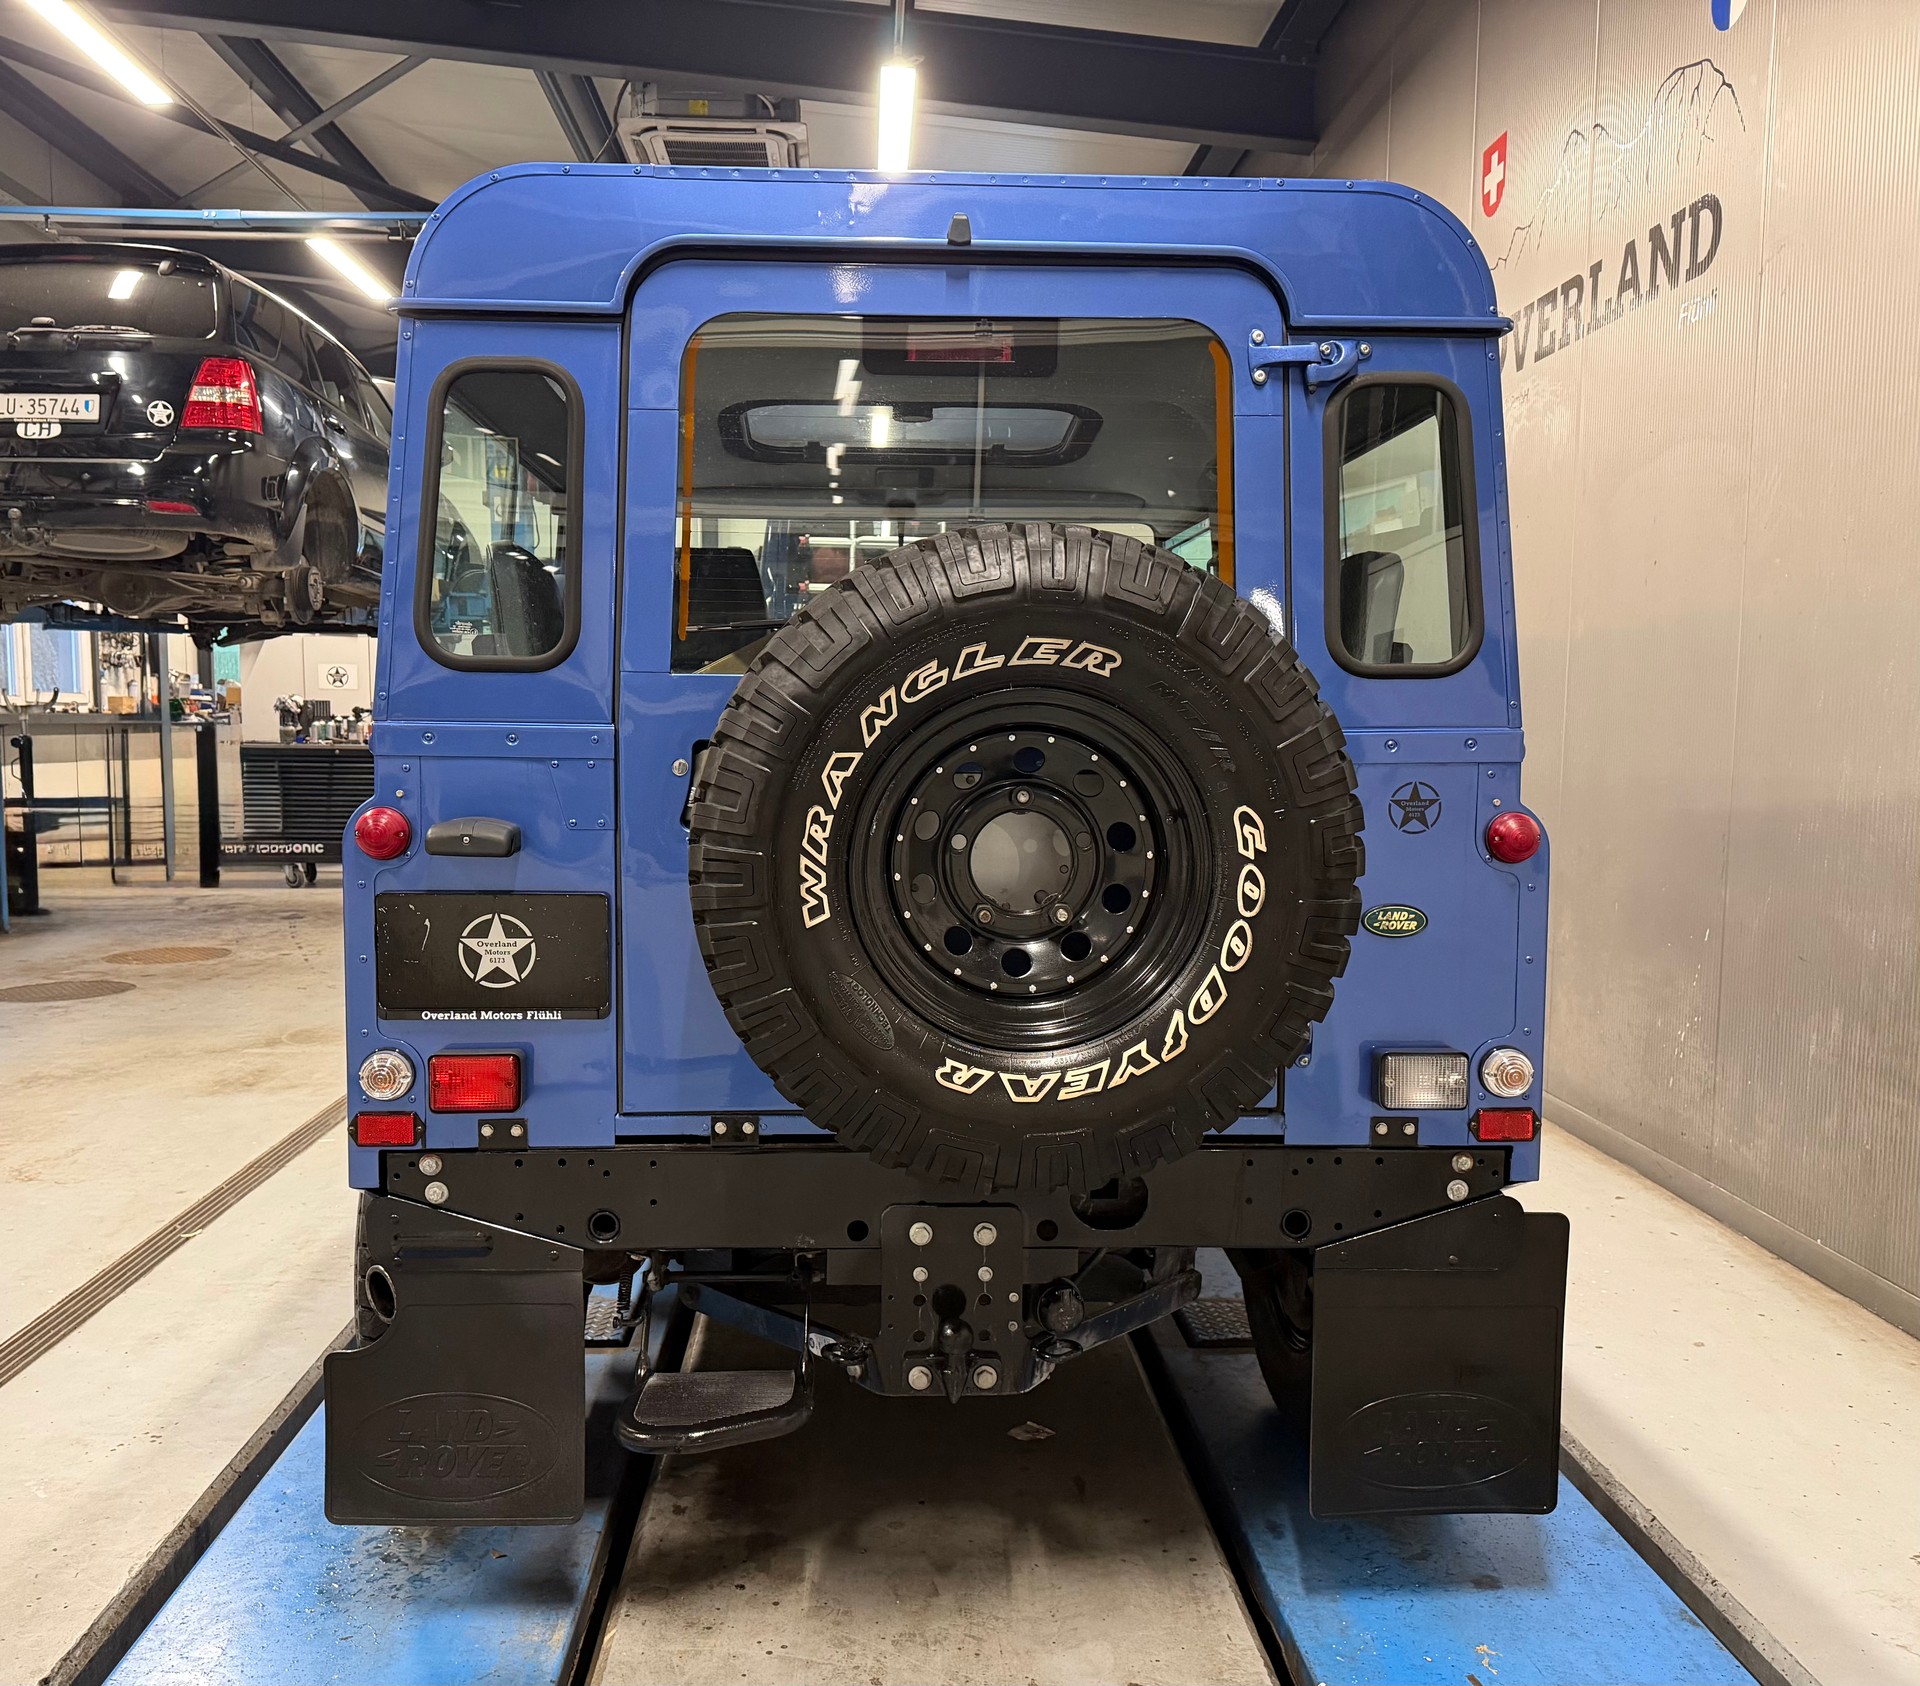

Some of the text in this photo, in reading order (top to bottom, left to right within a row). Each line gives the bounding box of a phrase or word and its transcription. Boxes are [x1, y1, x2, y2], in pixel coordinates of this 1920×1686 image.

[799, 636, 1123, 930] WRANGLER
[1378, 911, 1409, 921] LAND
[1379, 920, 1418, 931] ROVER
[476, 940, 518, 948] Overland
[934, 805, 1267, 1103] GOODYEAR
[421, 1010, 562, 1020] Overland Motors Flühli
[847, 979, 892, 1035] TECHNOLOGY
[388, 1409, 494, 1443] LAND
[396, 1444, 532, 1479] ROVER
